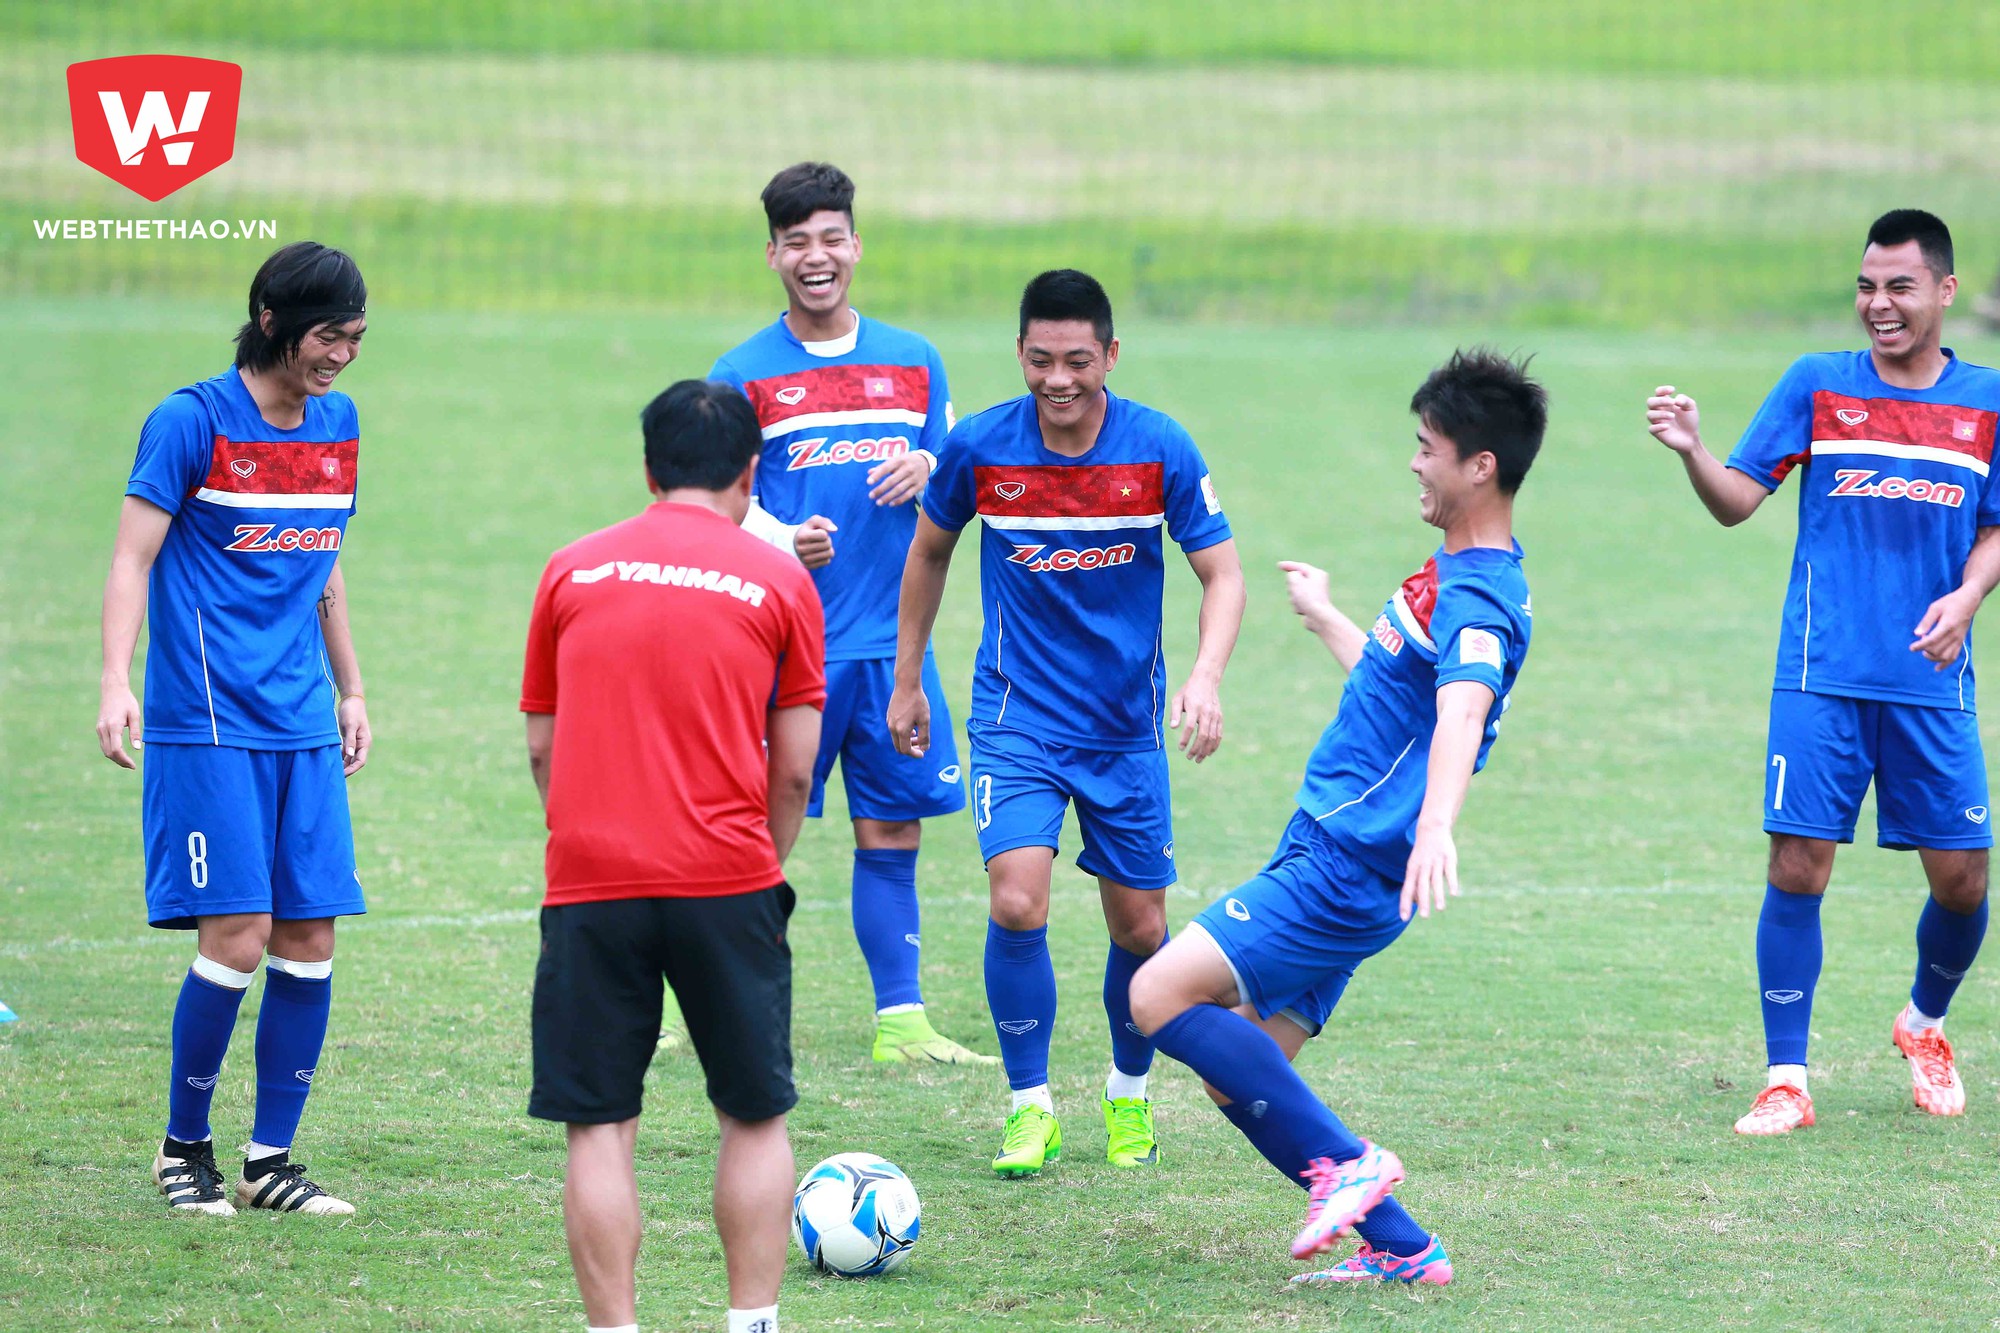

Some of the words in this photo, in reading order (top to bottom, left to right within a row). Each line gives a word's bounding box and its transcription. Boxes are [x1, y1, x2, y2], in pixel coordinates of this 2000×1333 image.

[786, 436, 910, 472] Z.com
[1827, 469, 1966, 508] Z.com
[223, 524, 342, 552] Z.com
[1006, 542, 1136, 572] Z.com
[615, 561, 767, 608] YANMAR
[188, 831, 208, 889] 8
